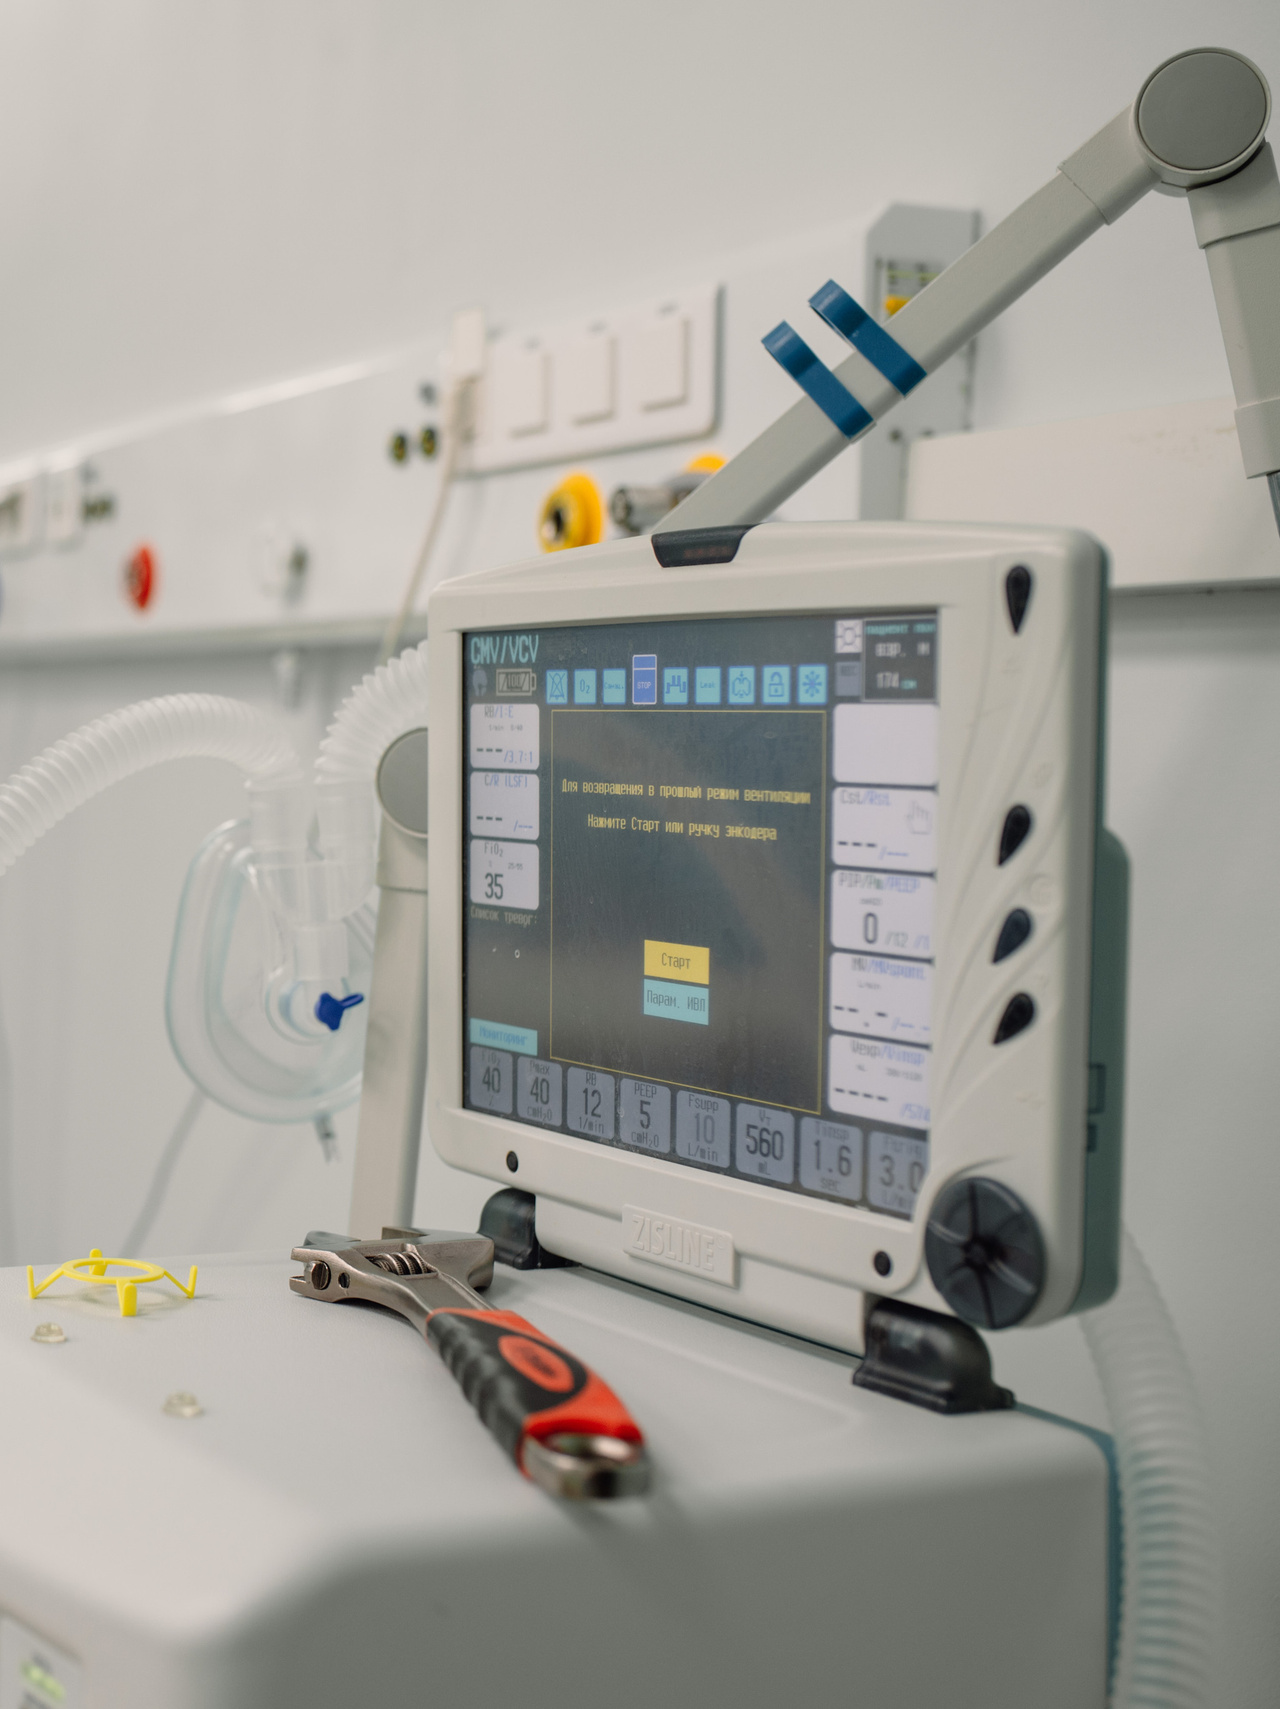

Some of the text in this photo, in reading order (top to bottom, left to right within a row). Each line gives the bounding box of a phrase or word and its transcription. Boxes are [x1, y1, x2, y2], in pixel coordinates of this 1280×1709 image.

[470, 635, 539, 664] CMV/VCV
[637, 682, 651, 690] STOP
[562, 778, 811, 805] Для возвращения в прошлый режим вентиляции
[587, 814, 778, 841] Нажмите Старт или ручку энкодера
[484, 872, 504, 900] 35
[661, 952, 691, 970] Старт
[646, 989, 706, 1012] Парам. ИВЛ
[482, 1066, 501, 1093] 40
[530, 1076, 550, 1105] 40
[634, 1082, 657, 1098] PEEP
[582, 1087, 602, 1118] 12
[639, 1100, 651, 1130] 5
[687, 1093, 719, 1113] Fsupp
[693, 1111, 716, 1145] 10
[745, 1123, 785, 1161] 560
[687, 1142, 719, 1163] L/min
[813, 1139, 852, 1177] 1.6
[878, 1153, 926, 1194] 3.0
[632, 1214, 715, 1272] ZISLINE
